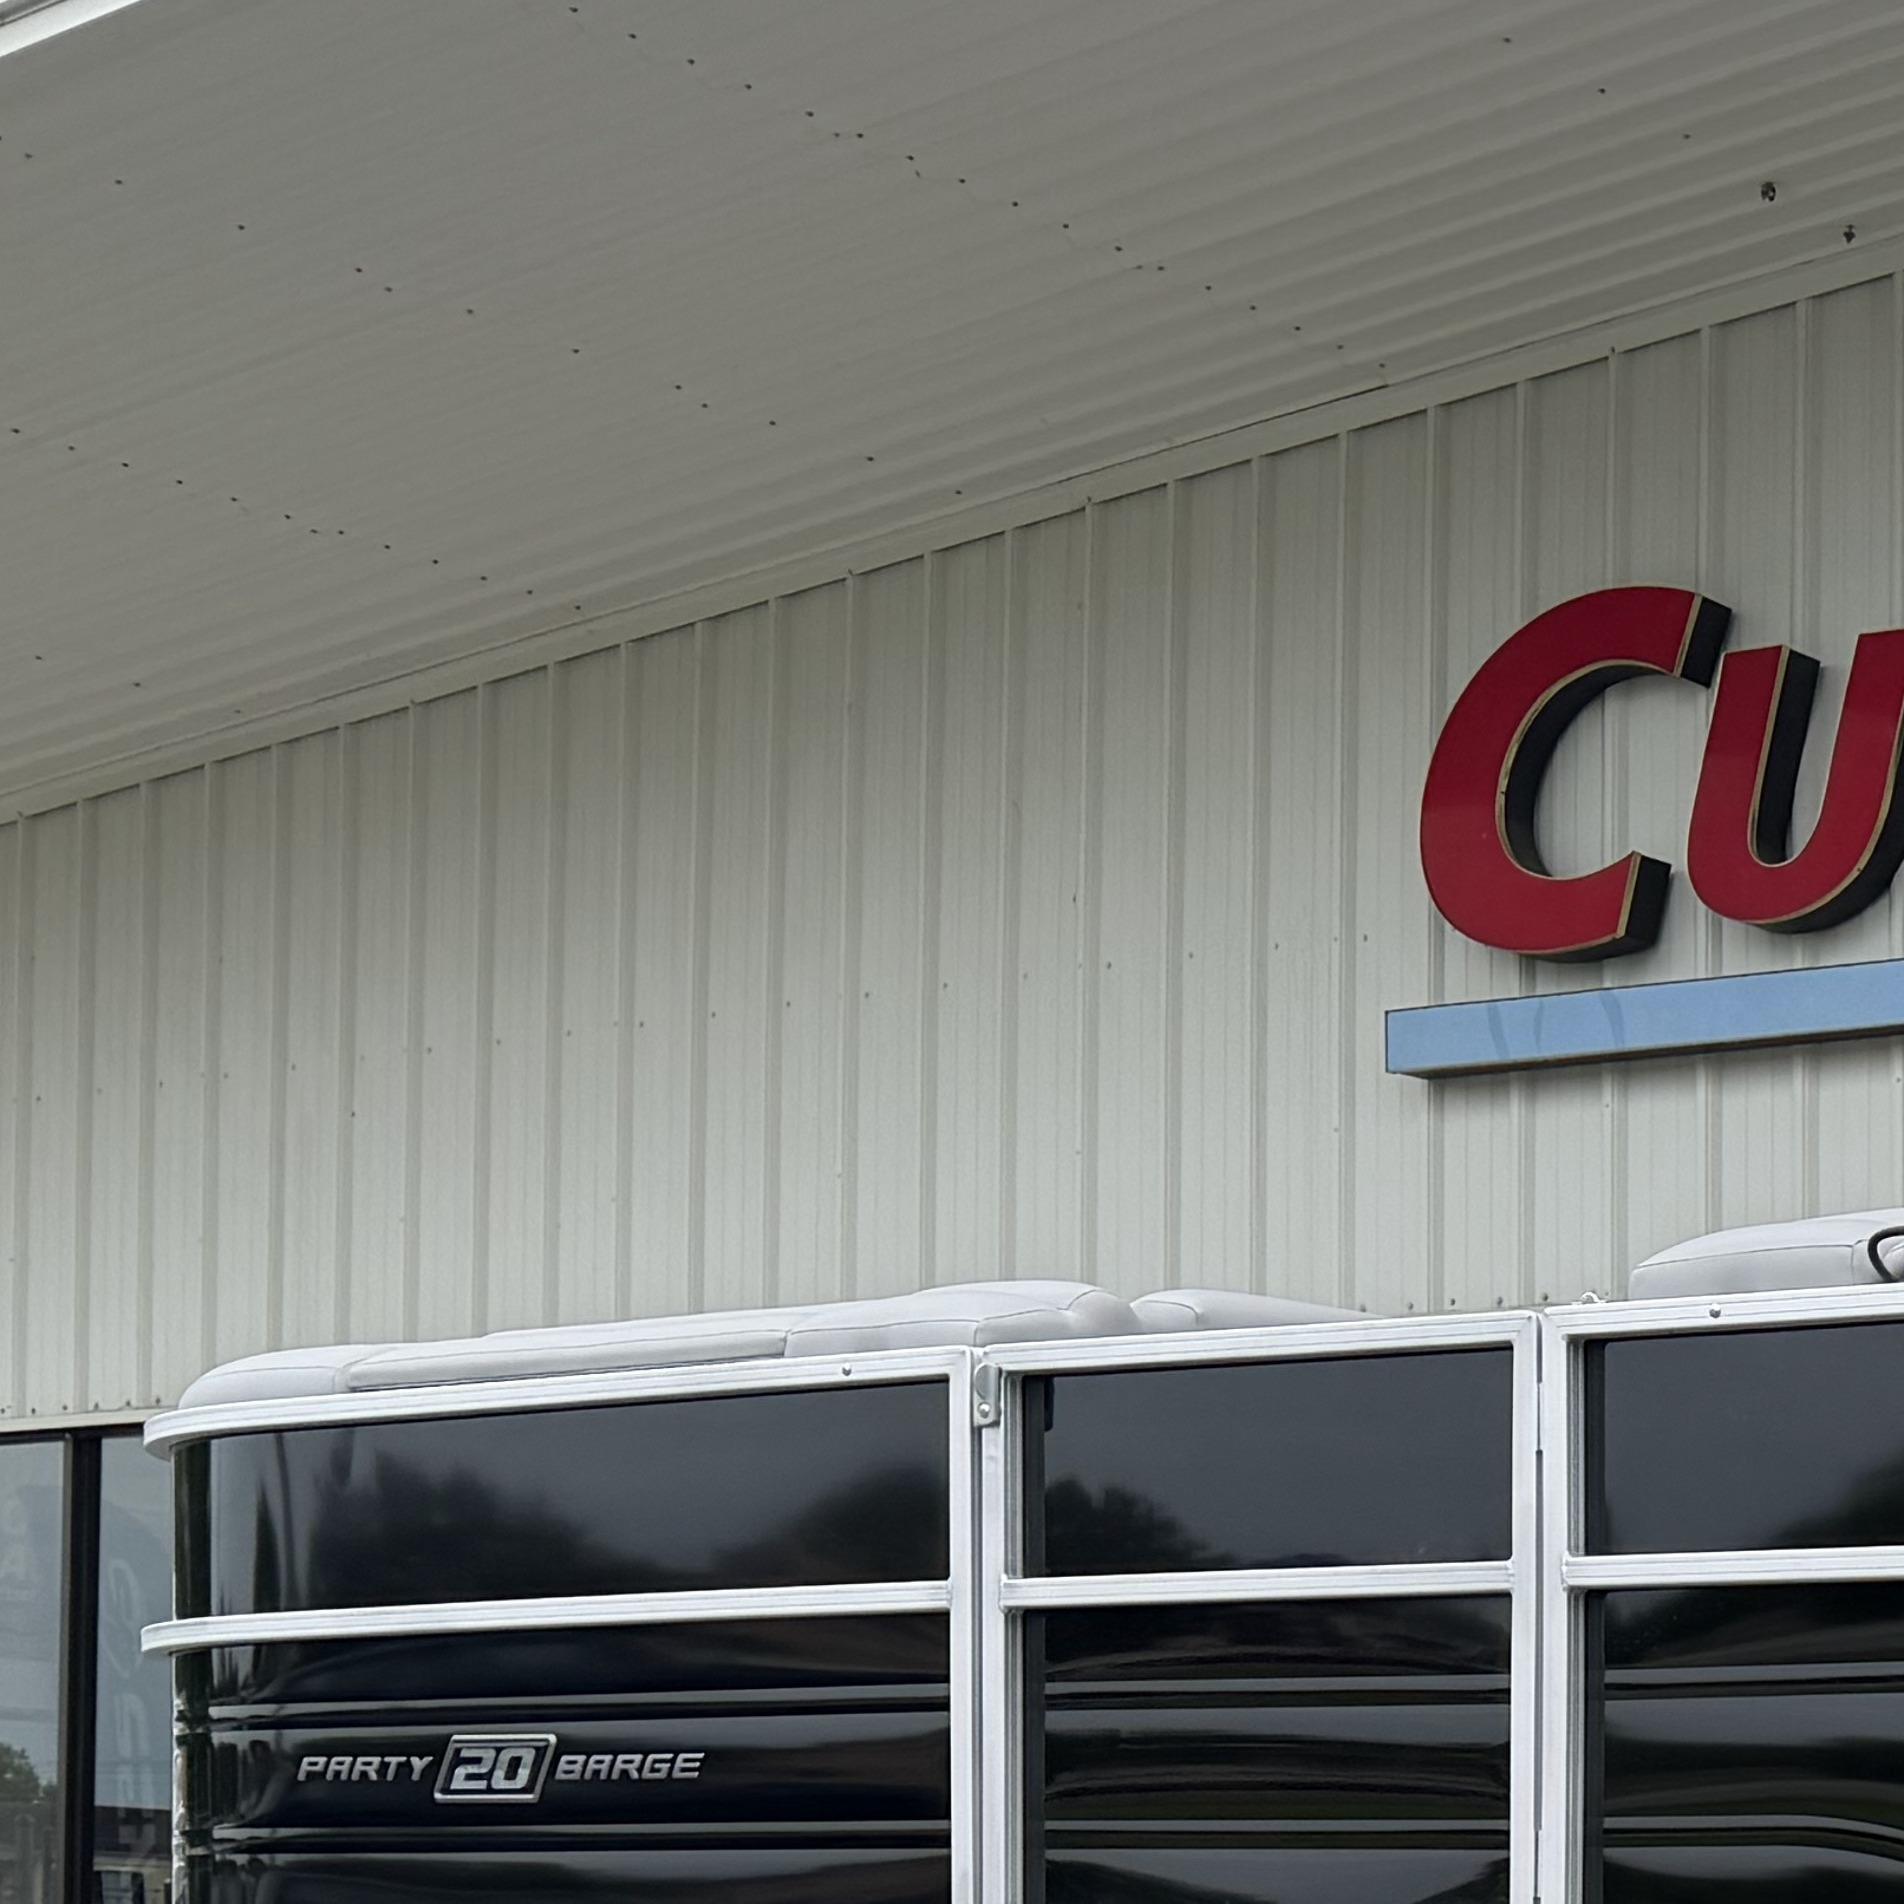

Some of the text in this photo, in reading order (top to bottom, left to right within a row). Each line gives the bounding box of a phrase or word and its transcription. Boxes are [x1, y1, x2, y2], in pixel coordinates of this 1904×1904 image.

[297, 1747, 705, 1790] PARTY 20 BARGE
